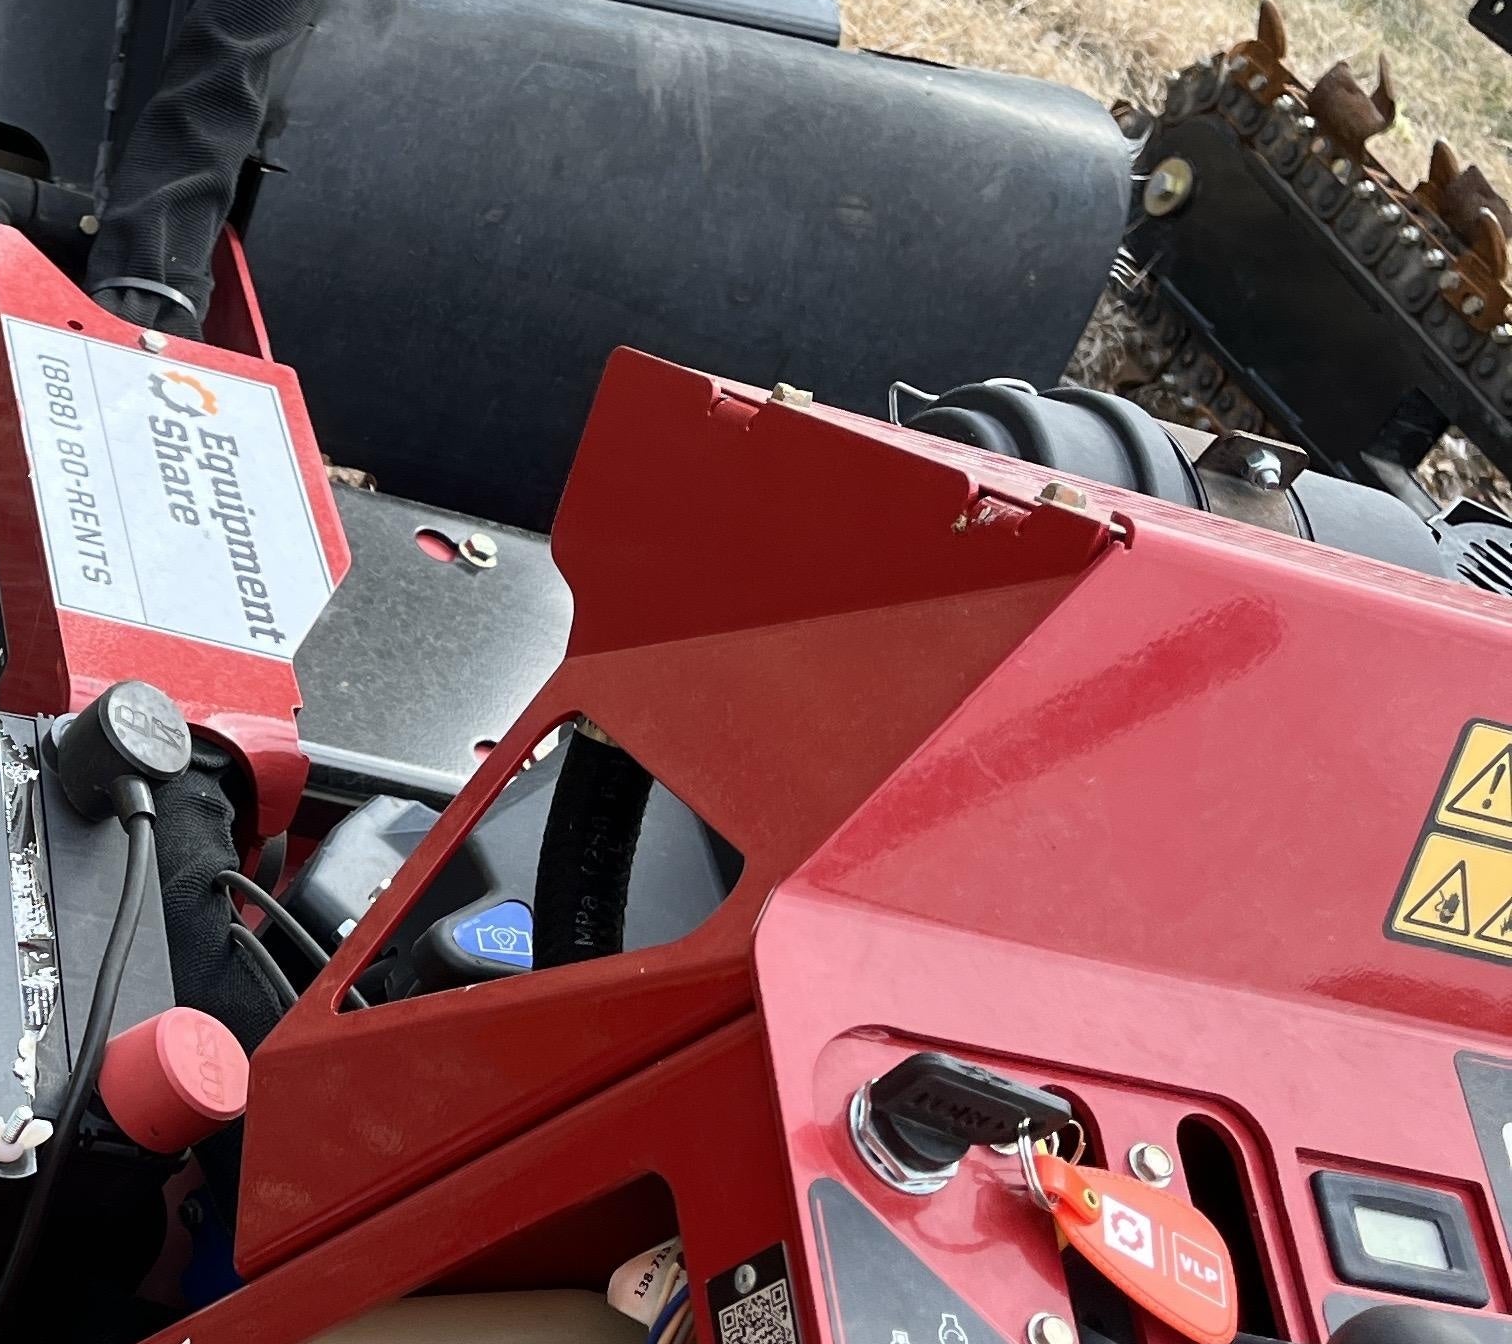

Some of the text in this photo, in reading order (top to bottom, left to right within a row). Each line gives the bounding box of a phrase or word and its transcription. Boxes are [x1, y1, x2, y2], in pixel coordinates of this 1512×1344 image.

[36, 353, 113, 587] (888) 80-RENTS
[147, 414, 200, 527] Share
[197, 428, 288, 645] Equipment
[1178, 1252, 1218, 1283] VLP
